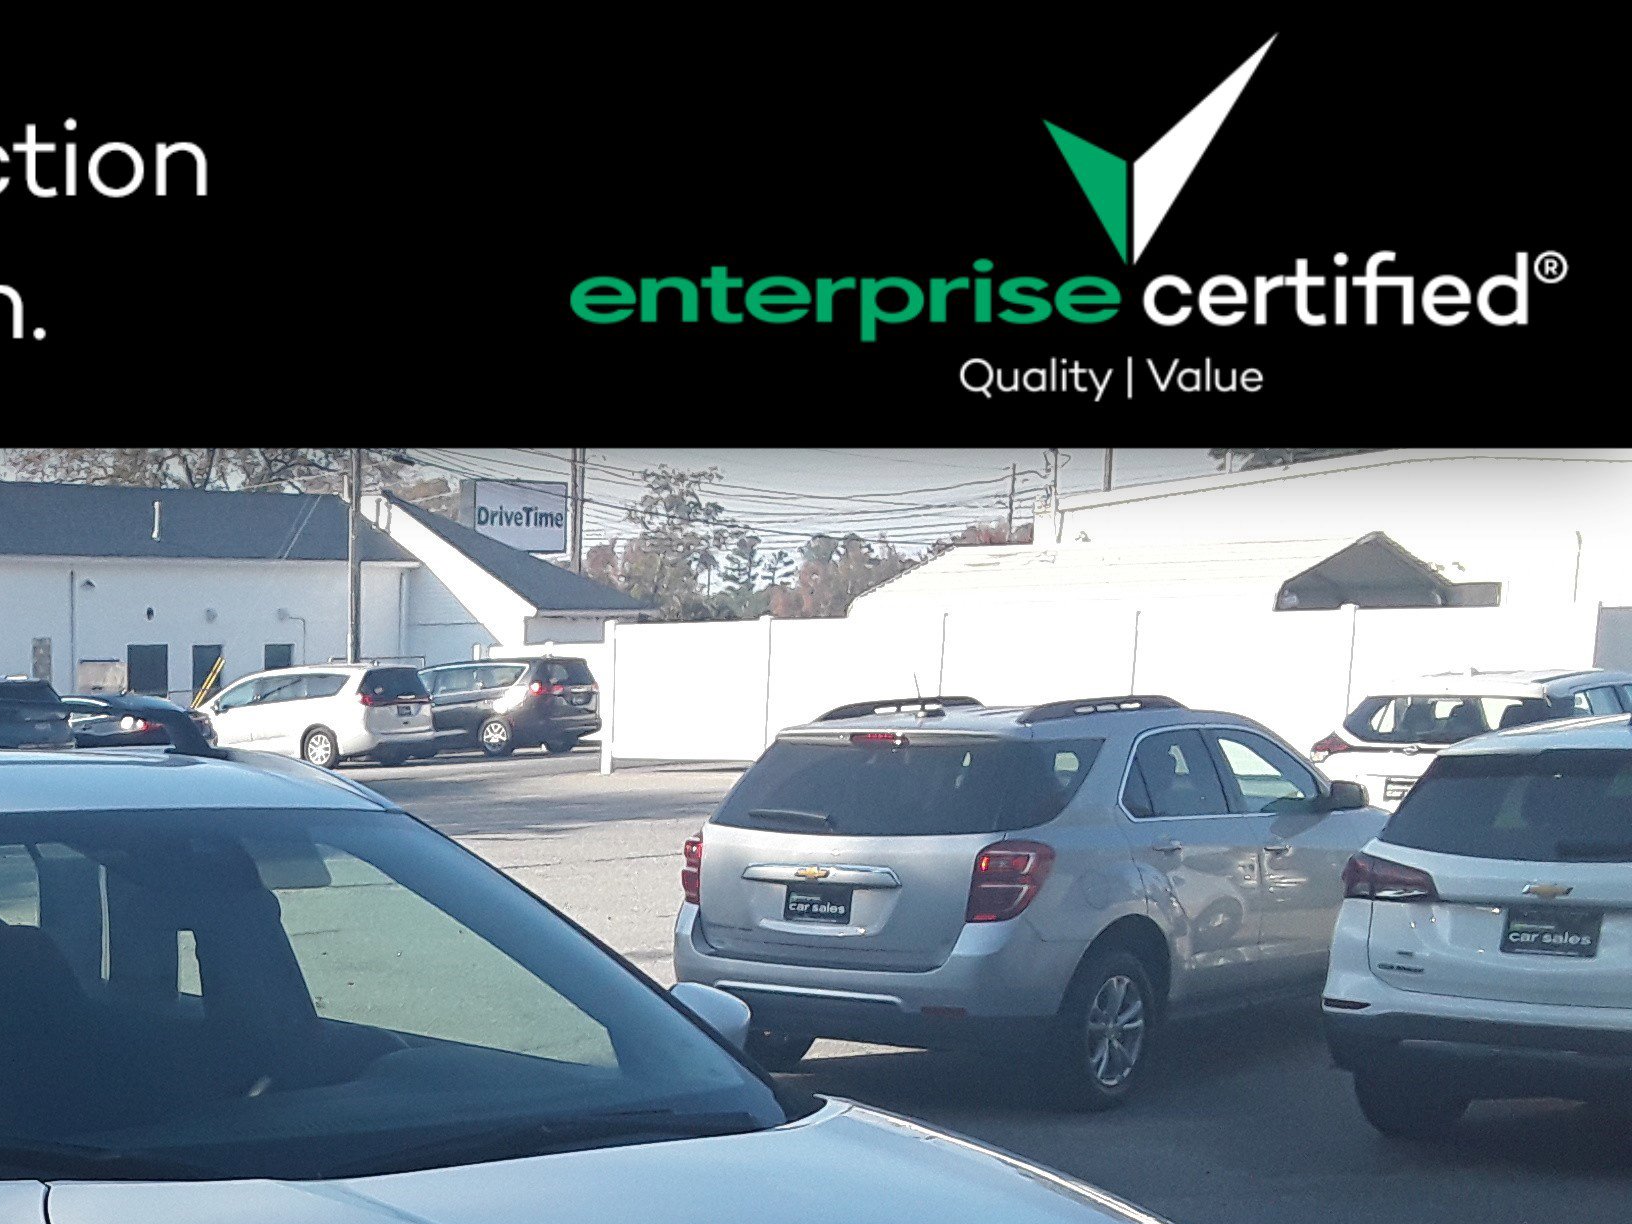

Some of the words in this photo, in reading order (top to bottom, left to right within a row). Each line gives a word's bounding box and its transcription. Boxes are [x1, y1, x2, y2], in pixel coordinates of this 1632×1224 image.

[477, 505, 564, 528] DriveTime
[789, 902, 810, 911] car
[812, 901, 845, 914] sales
[1508, 931, 1540, 943] car
[1541, 931, 1591, 946] sales
